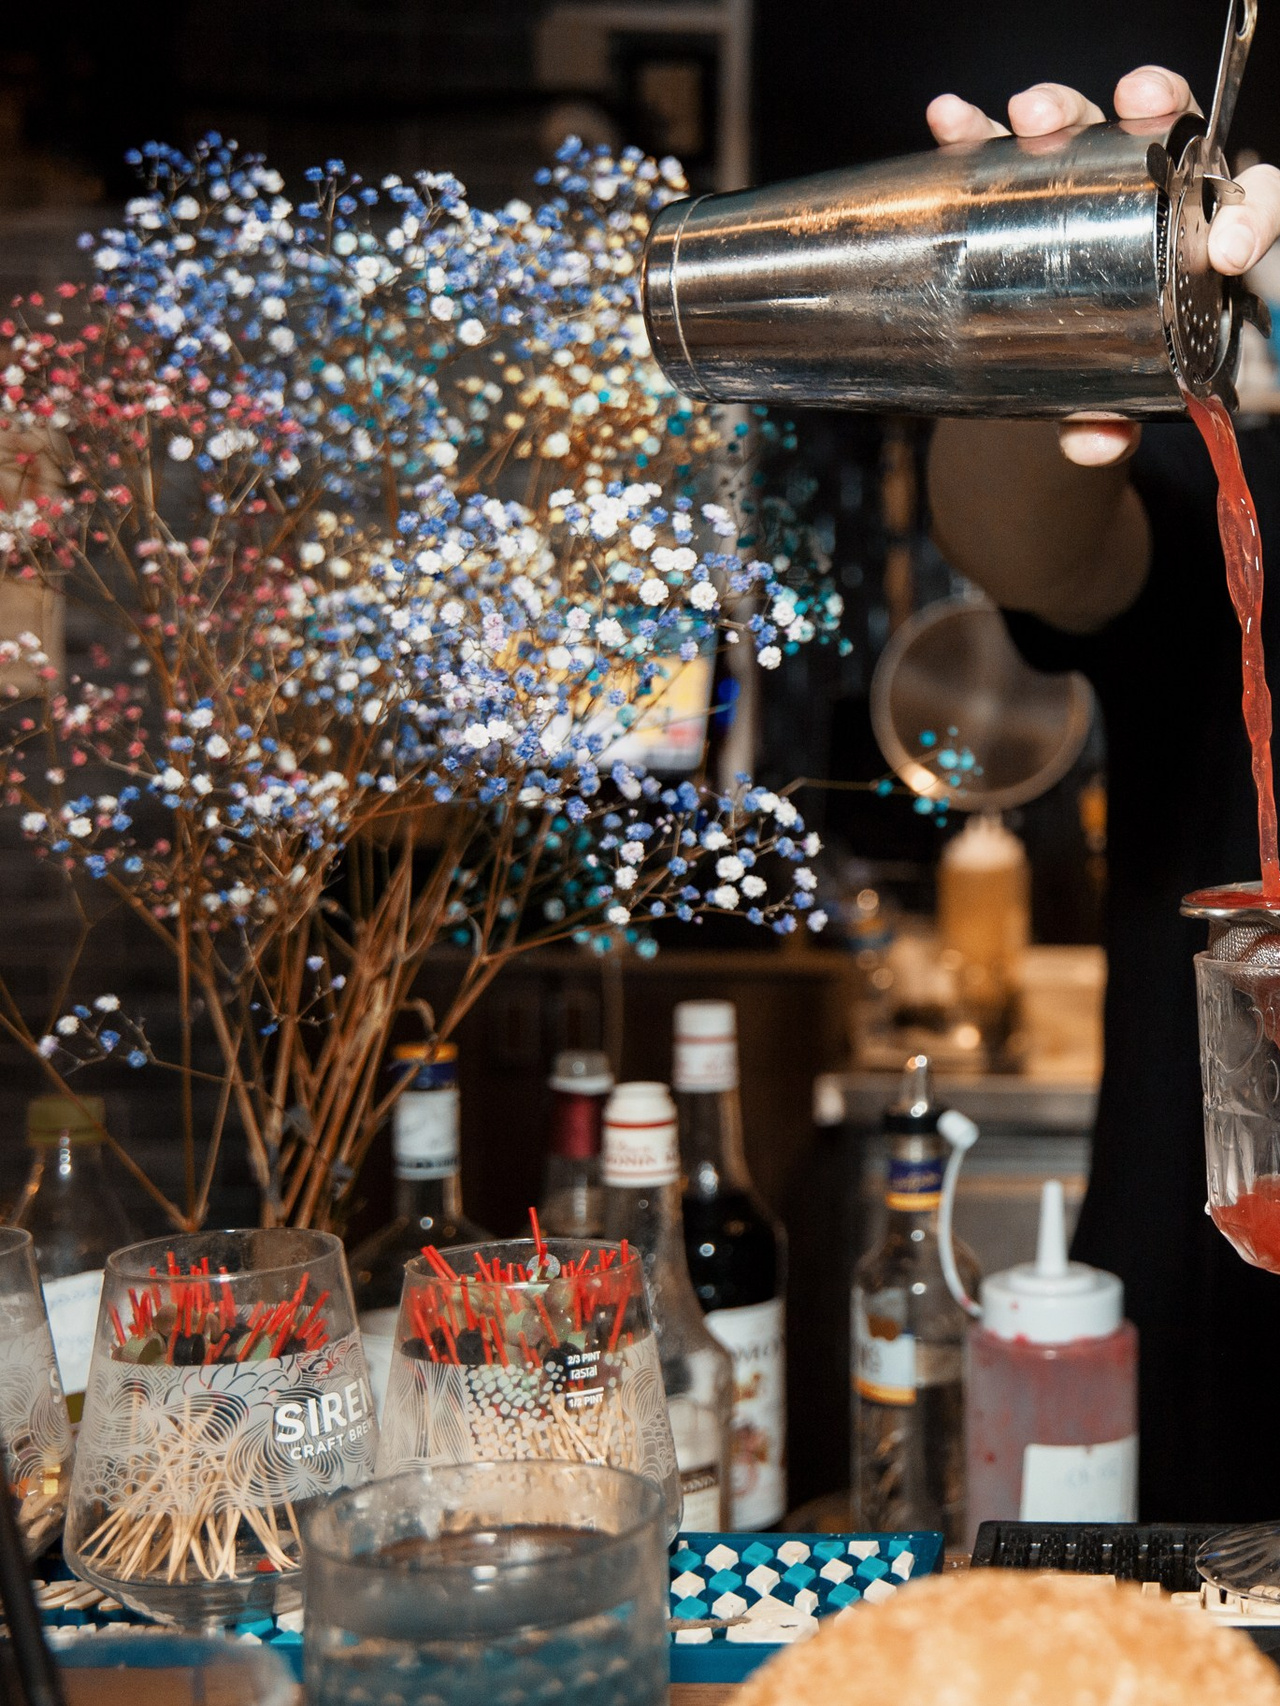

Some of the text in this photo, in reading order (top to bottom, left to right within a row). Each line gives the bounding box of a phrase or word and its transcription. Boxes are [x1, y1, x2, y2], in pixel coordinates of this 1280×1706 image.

[566, 1350, 601, 1366] 2/3 PINT
[567, 1393, 604, 1408] 1/2 PINT
[289, 1433, 345, 1461] CRAFT
